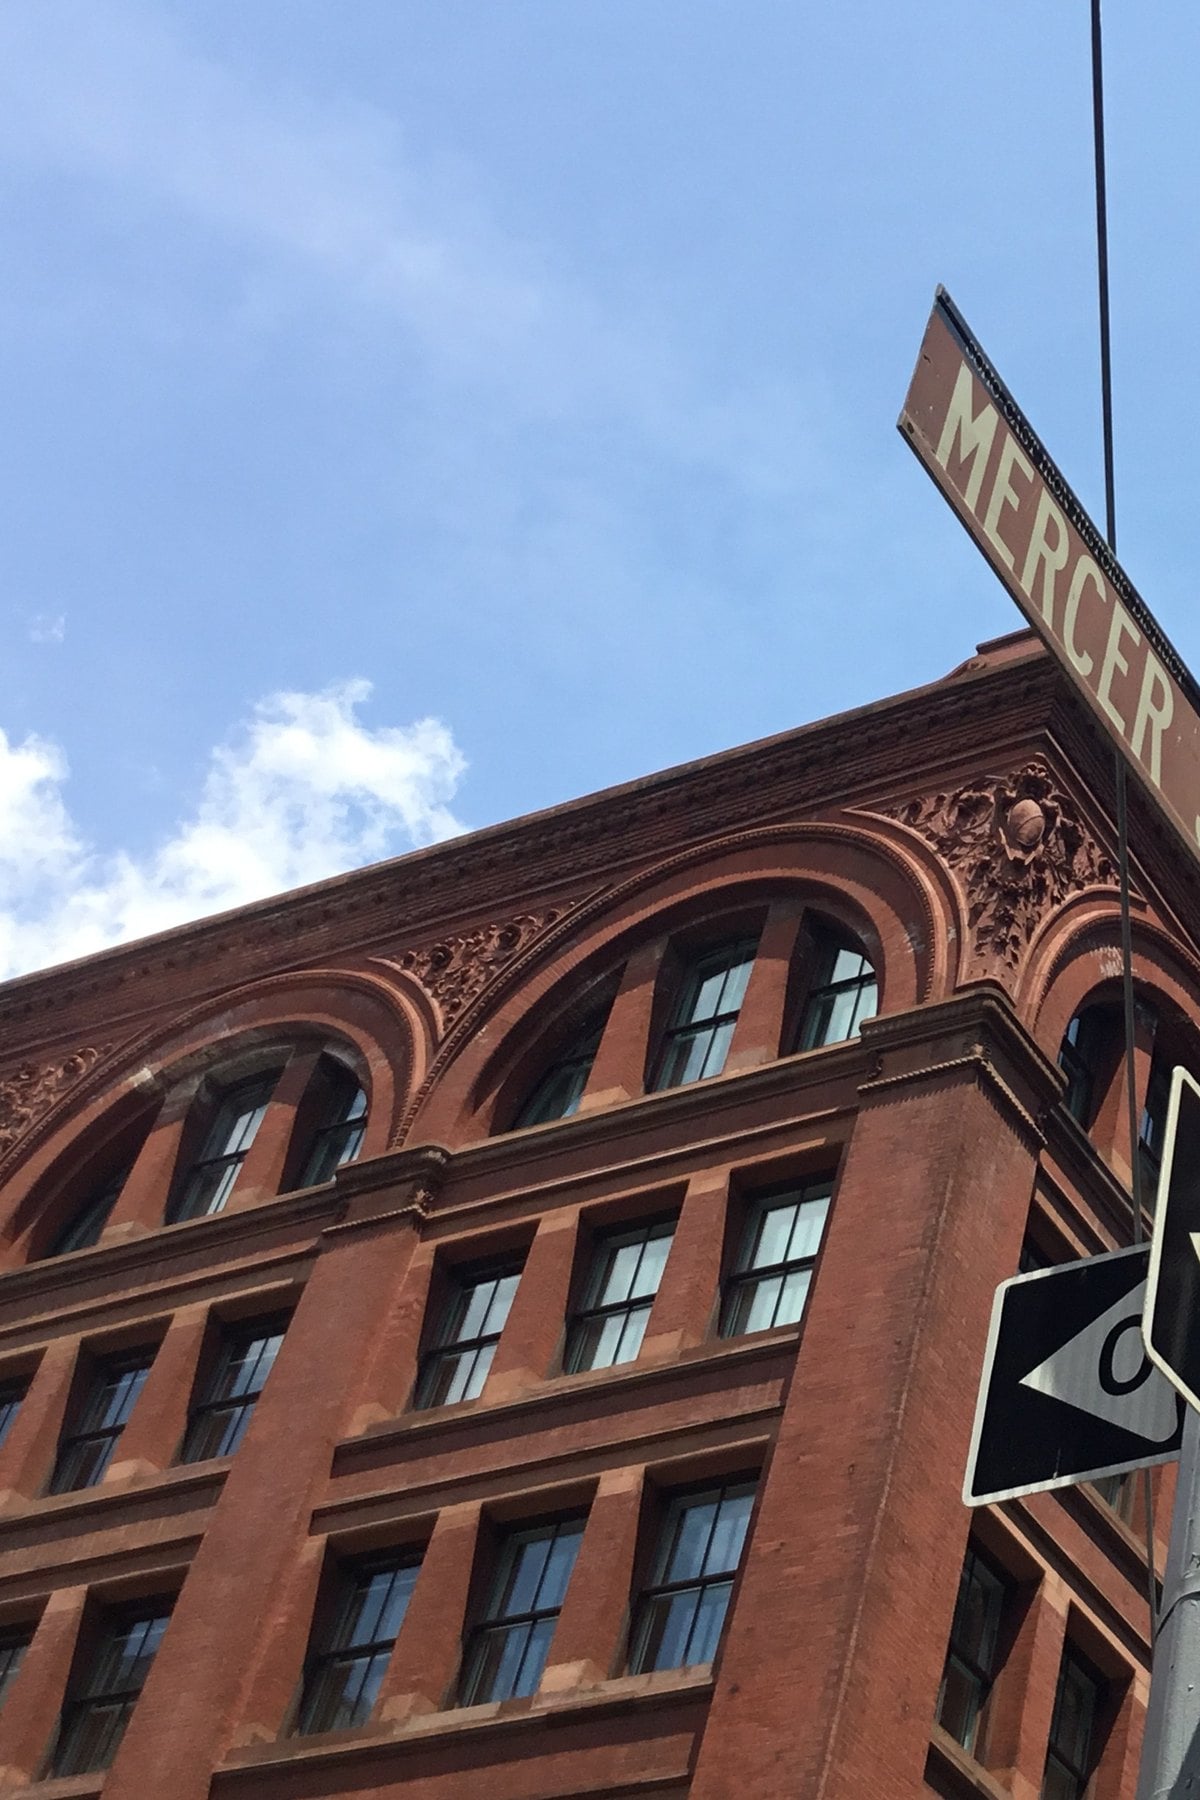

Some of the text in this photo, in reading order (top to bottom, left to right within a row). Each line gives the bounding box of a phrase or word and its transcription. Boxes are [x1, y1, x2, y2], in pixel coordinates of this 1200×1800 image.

[935, 361, 1173, 790] MERCER
[1039, 453, 1072, 508] IRON
[1072, 503, 1132, 600] HISTORIC
[1132, 599, 1188, 684] DISTRICT
